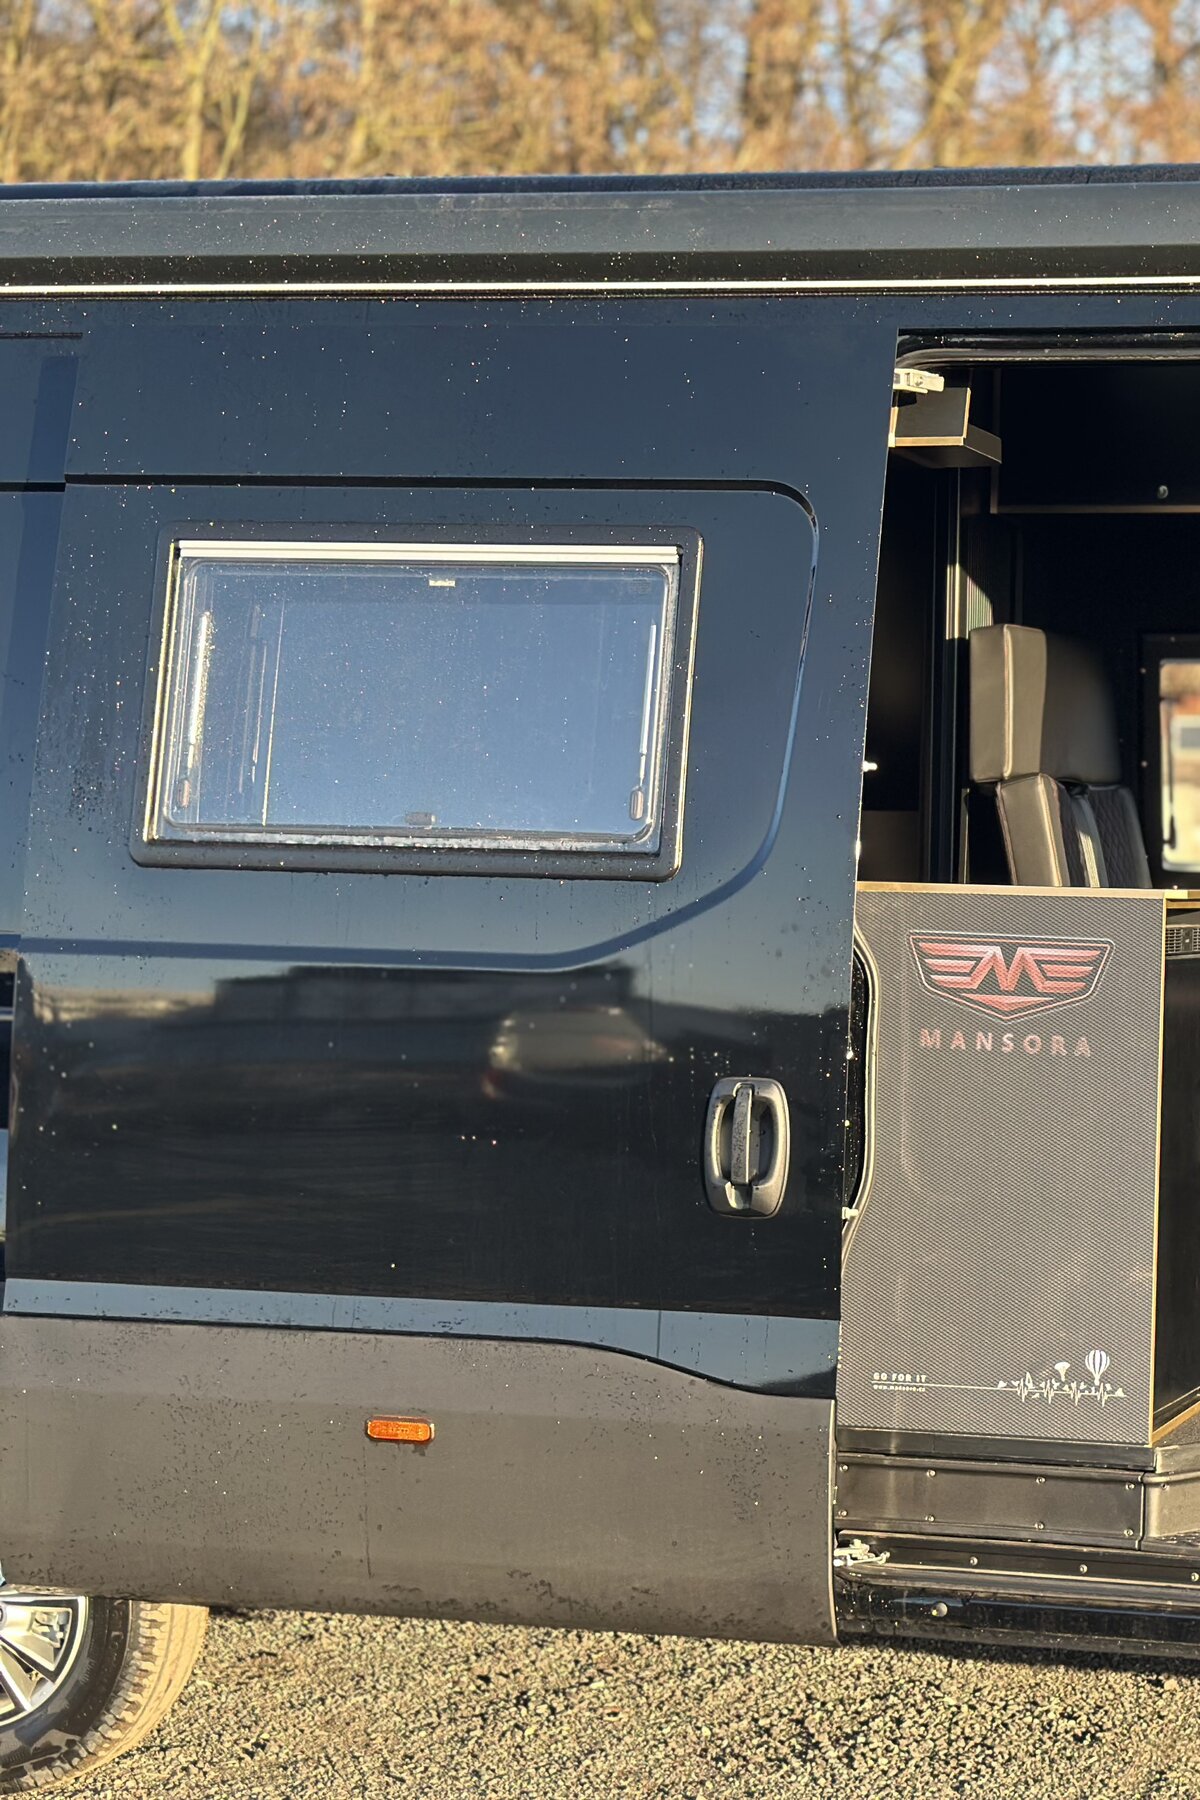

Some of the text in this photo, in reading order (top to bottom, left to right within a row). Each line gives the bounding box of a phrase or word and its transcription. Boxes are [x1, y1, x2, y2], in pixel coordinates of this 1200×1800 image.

[919, 1027, 1092, 1057] MANSORA
[873, 1372, 927, 1383] GO FOR IT
